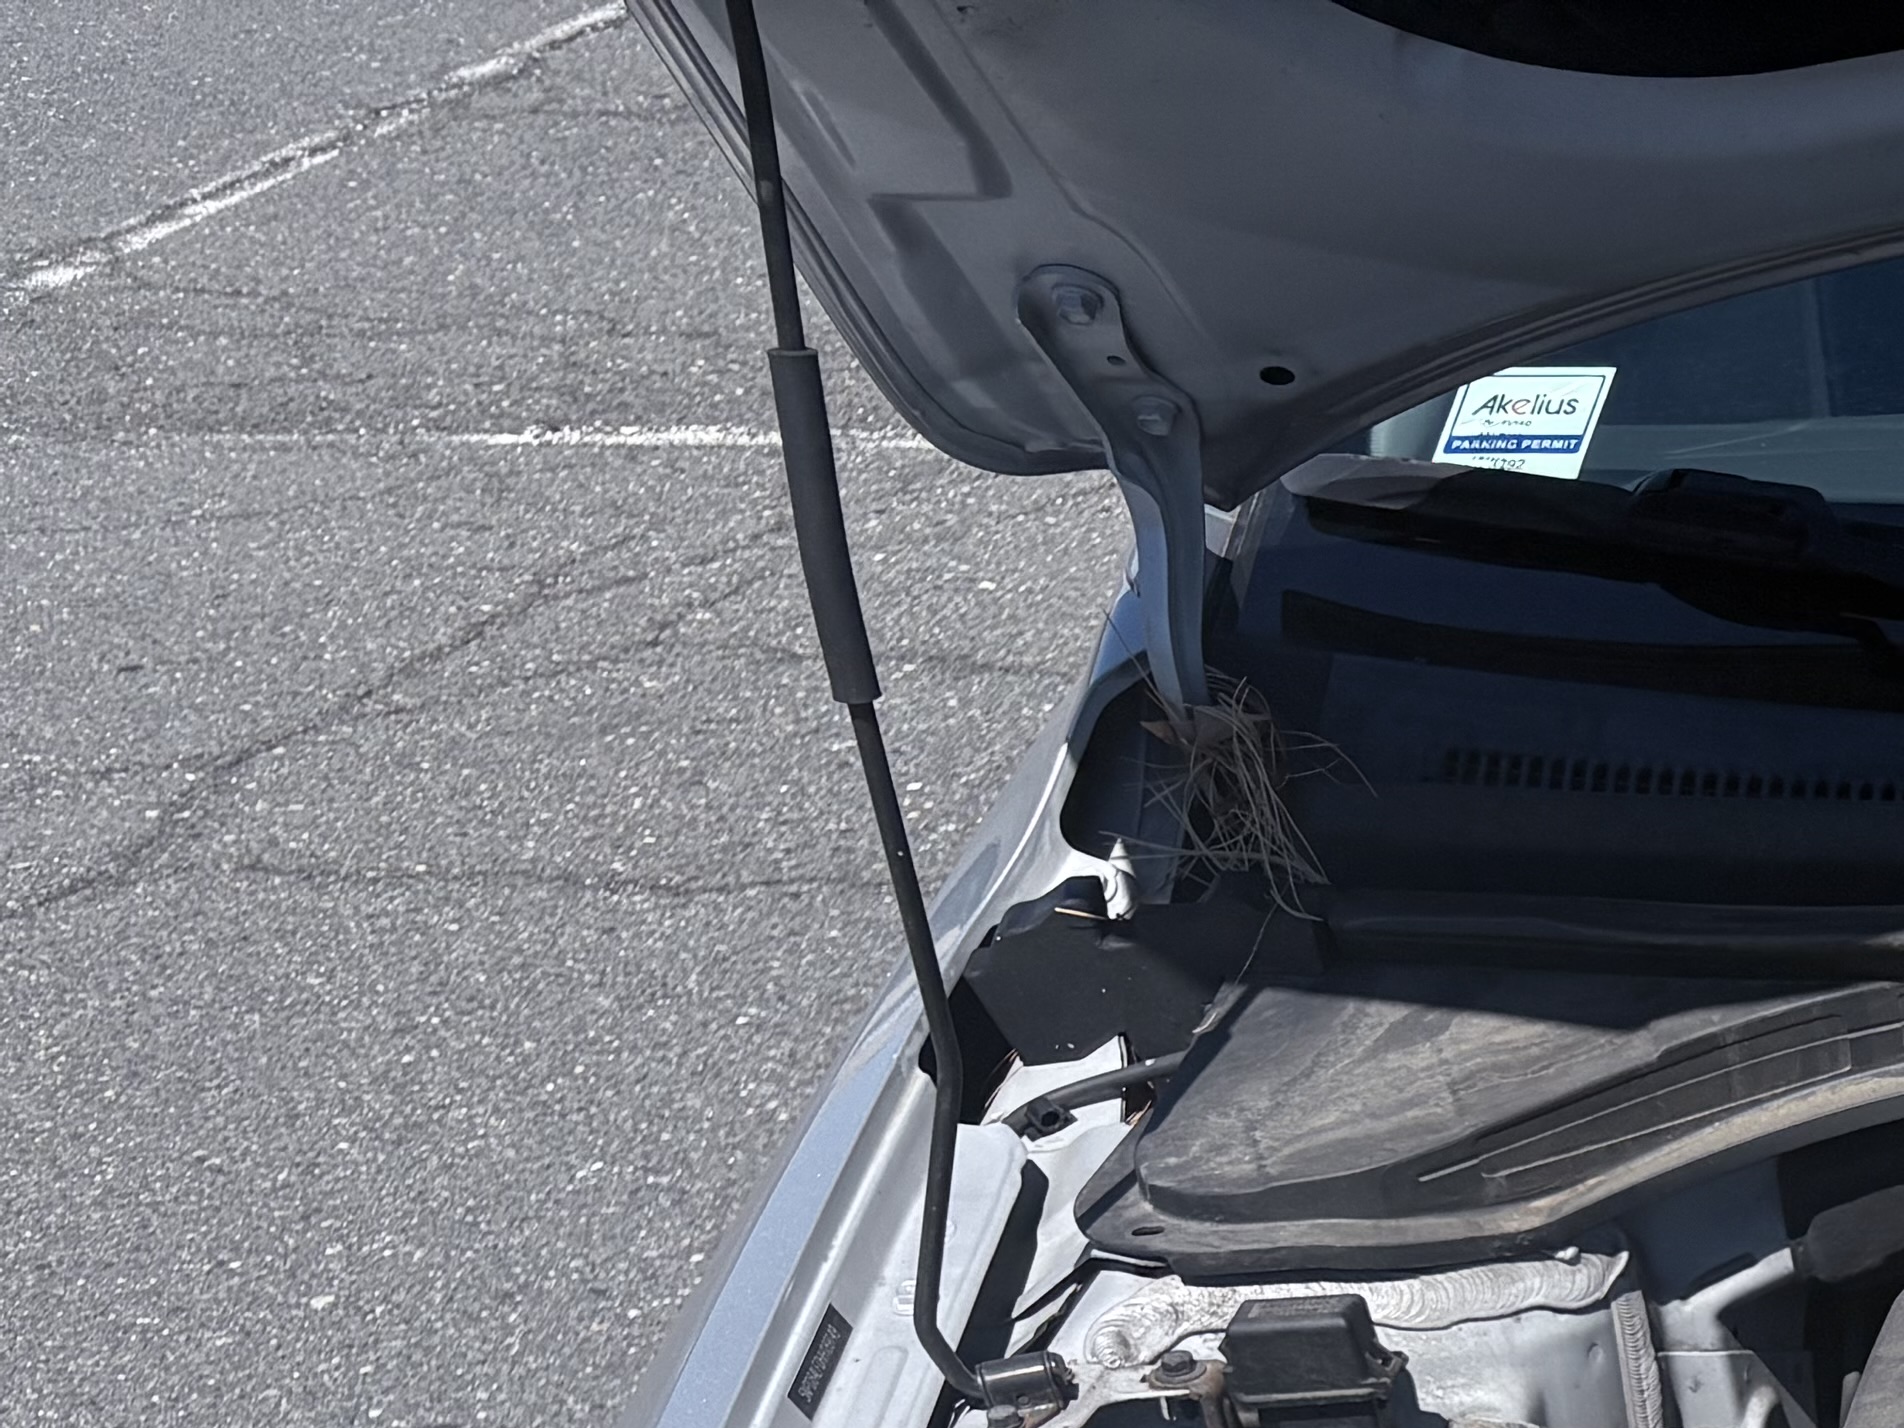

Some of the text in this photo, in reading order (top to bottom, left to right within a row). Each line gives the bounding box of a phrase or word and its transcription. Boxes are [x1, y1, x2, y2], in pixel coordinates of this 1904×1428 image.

[1472, 393, 1580, 417] Akelius
[1451, 439, 1579, 450] PARKING PERMIT
